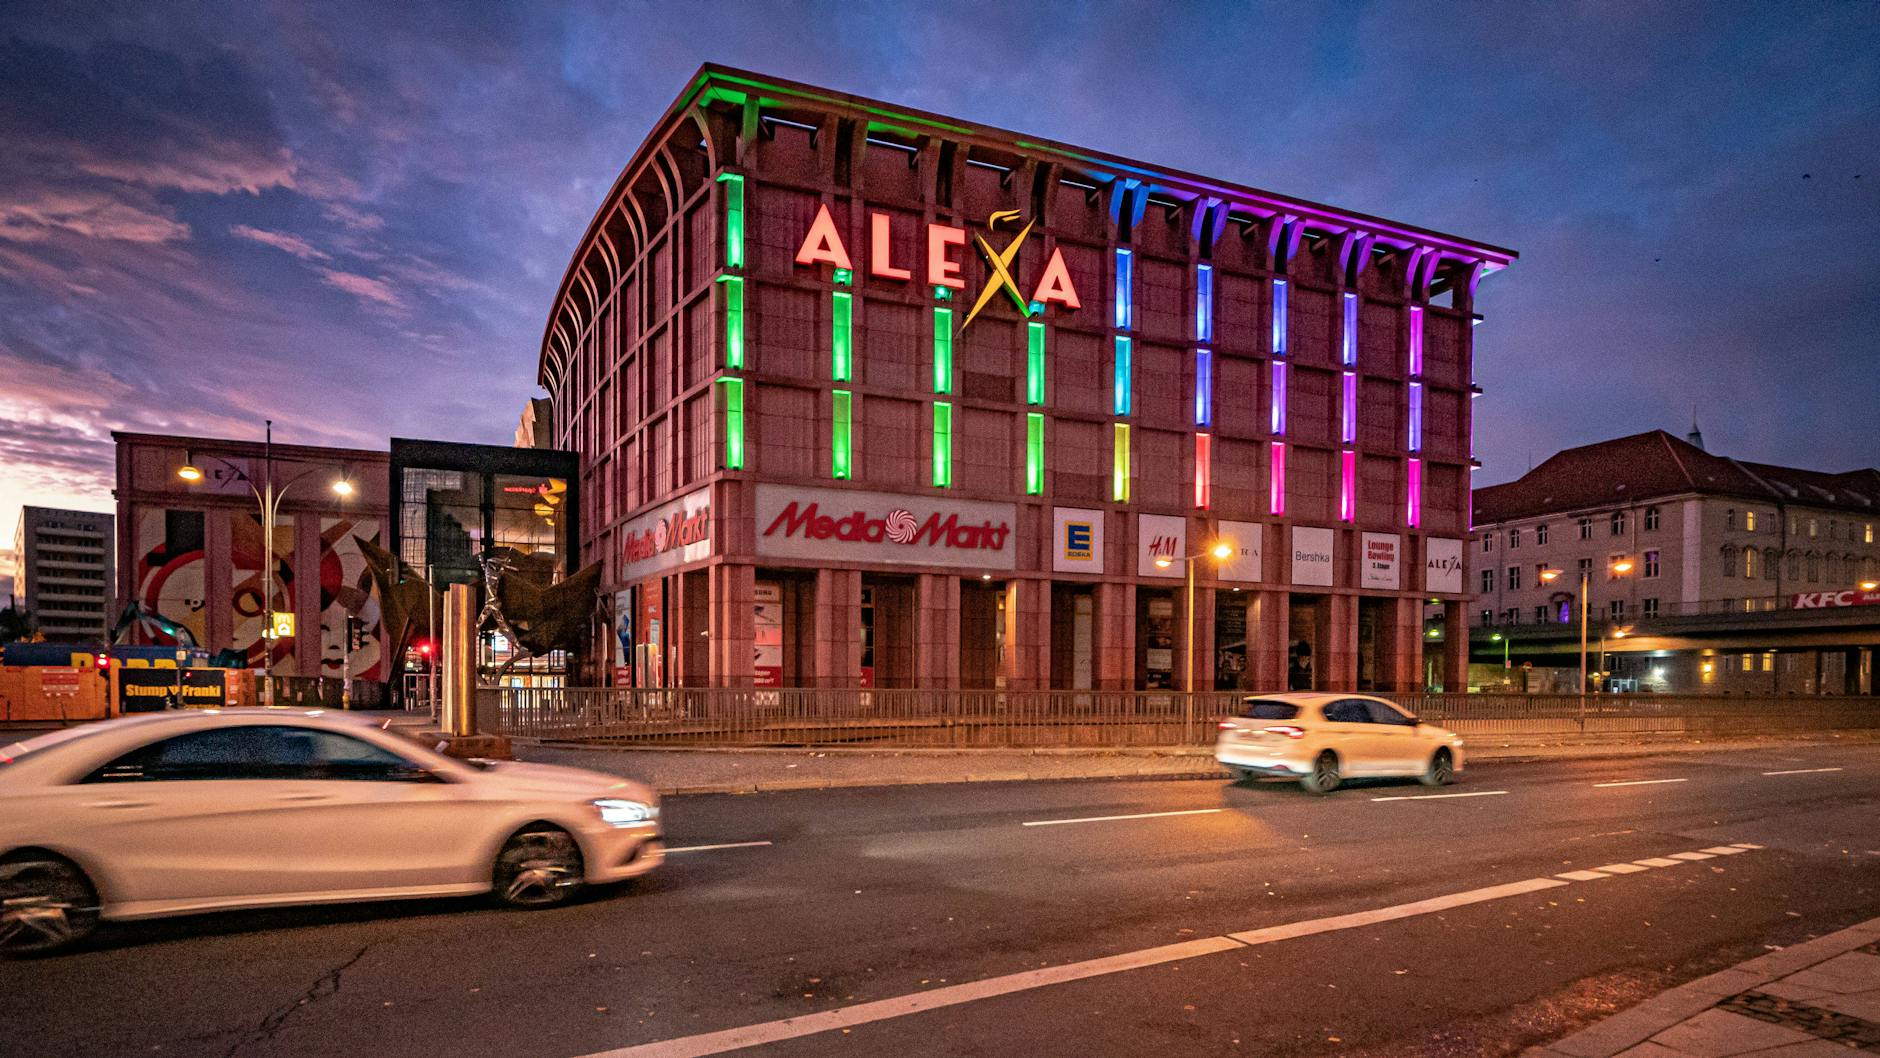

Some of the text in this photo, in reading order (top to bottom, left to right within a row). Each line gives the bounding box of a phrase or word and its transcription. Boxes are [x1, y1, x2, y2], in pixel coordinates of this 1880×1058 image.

[795, 203, 1081, 338] ALEXA
[623, 506, 709, 565] Media Markt
[763, 501, 1010, 550] Media Markt
[1148, 535, 1178, 557] H&M
[1367, 540, 1394, 552] Lounge
[1295, 550, 1330, 563] Bershka
[1367, 551, 1395, 562] Bowling
[1428, 554, 1462, 577] ALEXA
[1794, 590, 1854, 609] KFC
[125, 684, 168, 698] Stump
